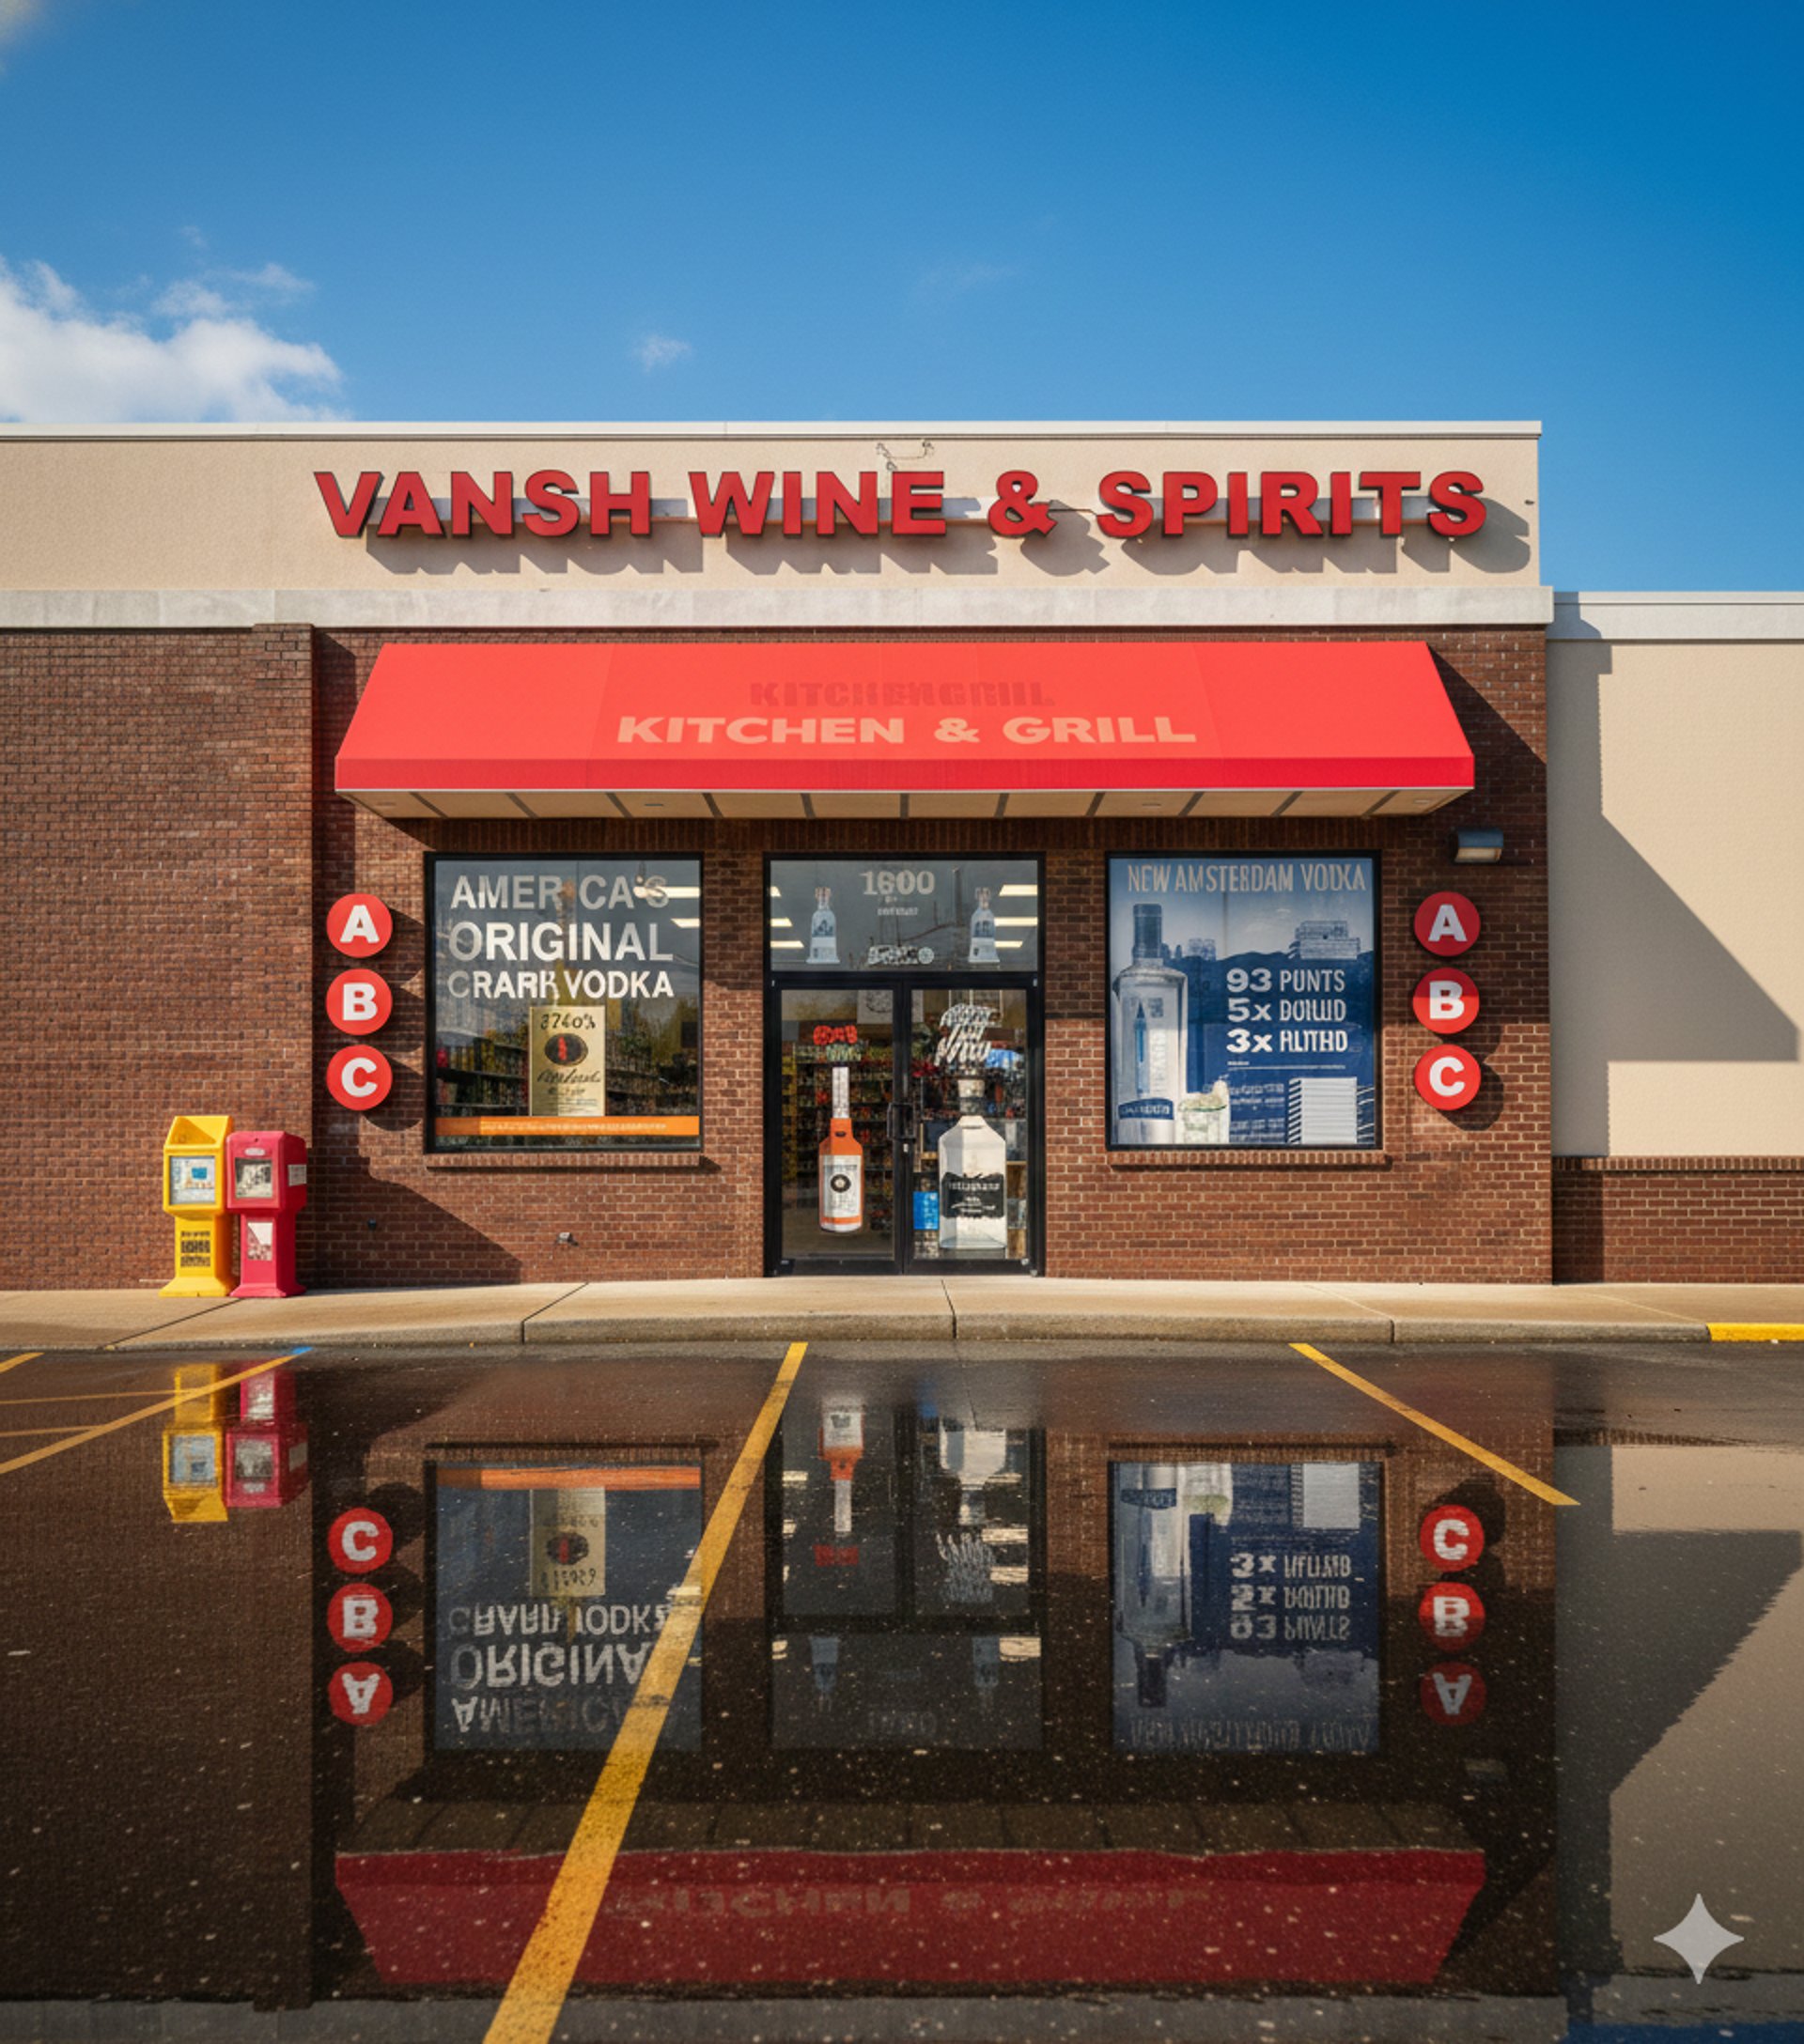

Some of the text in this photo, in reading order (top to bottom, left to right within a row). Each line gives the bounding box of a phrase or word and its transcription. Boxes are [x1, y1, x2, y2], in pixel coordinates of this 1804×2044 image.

[313, 469, 1487, 538] VANSH WINE & SPIRITS
[617, 717, 1197, 744] KITCHEN & GRILL
[859, 869, 936, 895] 1600
[1128, 863, 1172, 893] NEW
[339, 905, 380, 943] A
[448, 921, 674, 962] ORIGINAL
[1427, 904, 1468, 942] A
[564, 970, 675, 999] VODKA
[1226, 968, 1272, 992] 93
[343, 983, 378, 1021] B
[1429, 981, 1465, 1020] B
[1226, 1029, 1272, 1053] 3x
[341, 1057, 378, 1098] C
[1429, 1056, 1466, 1097] C
